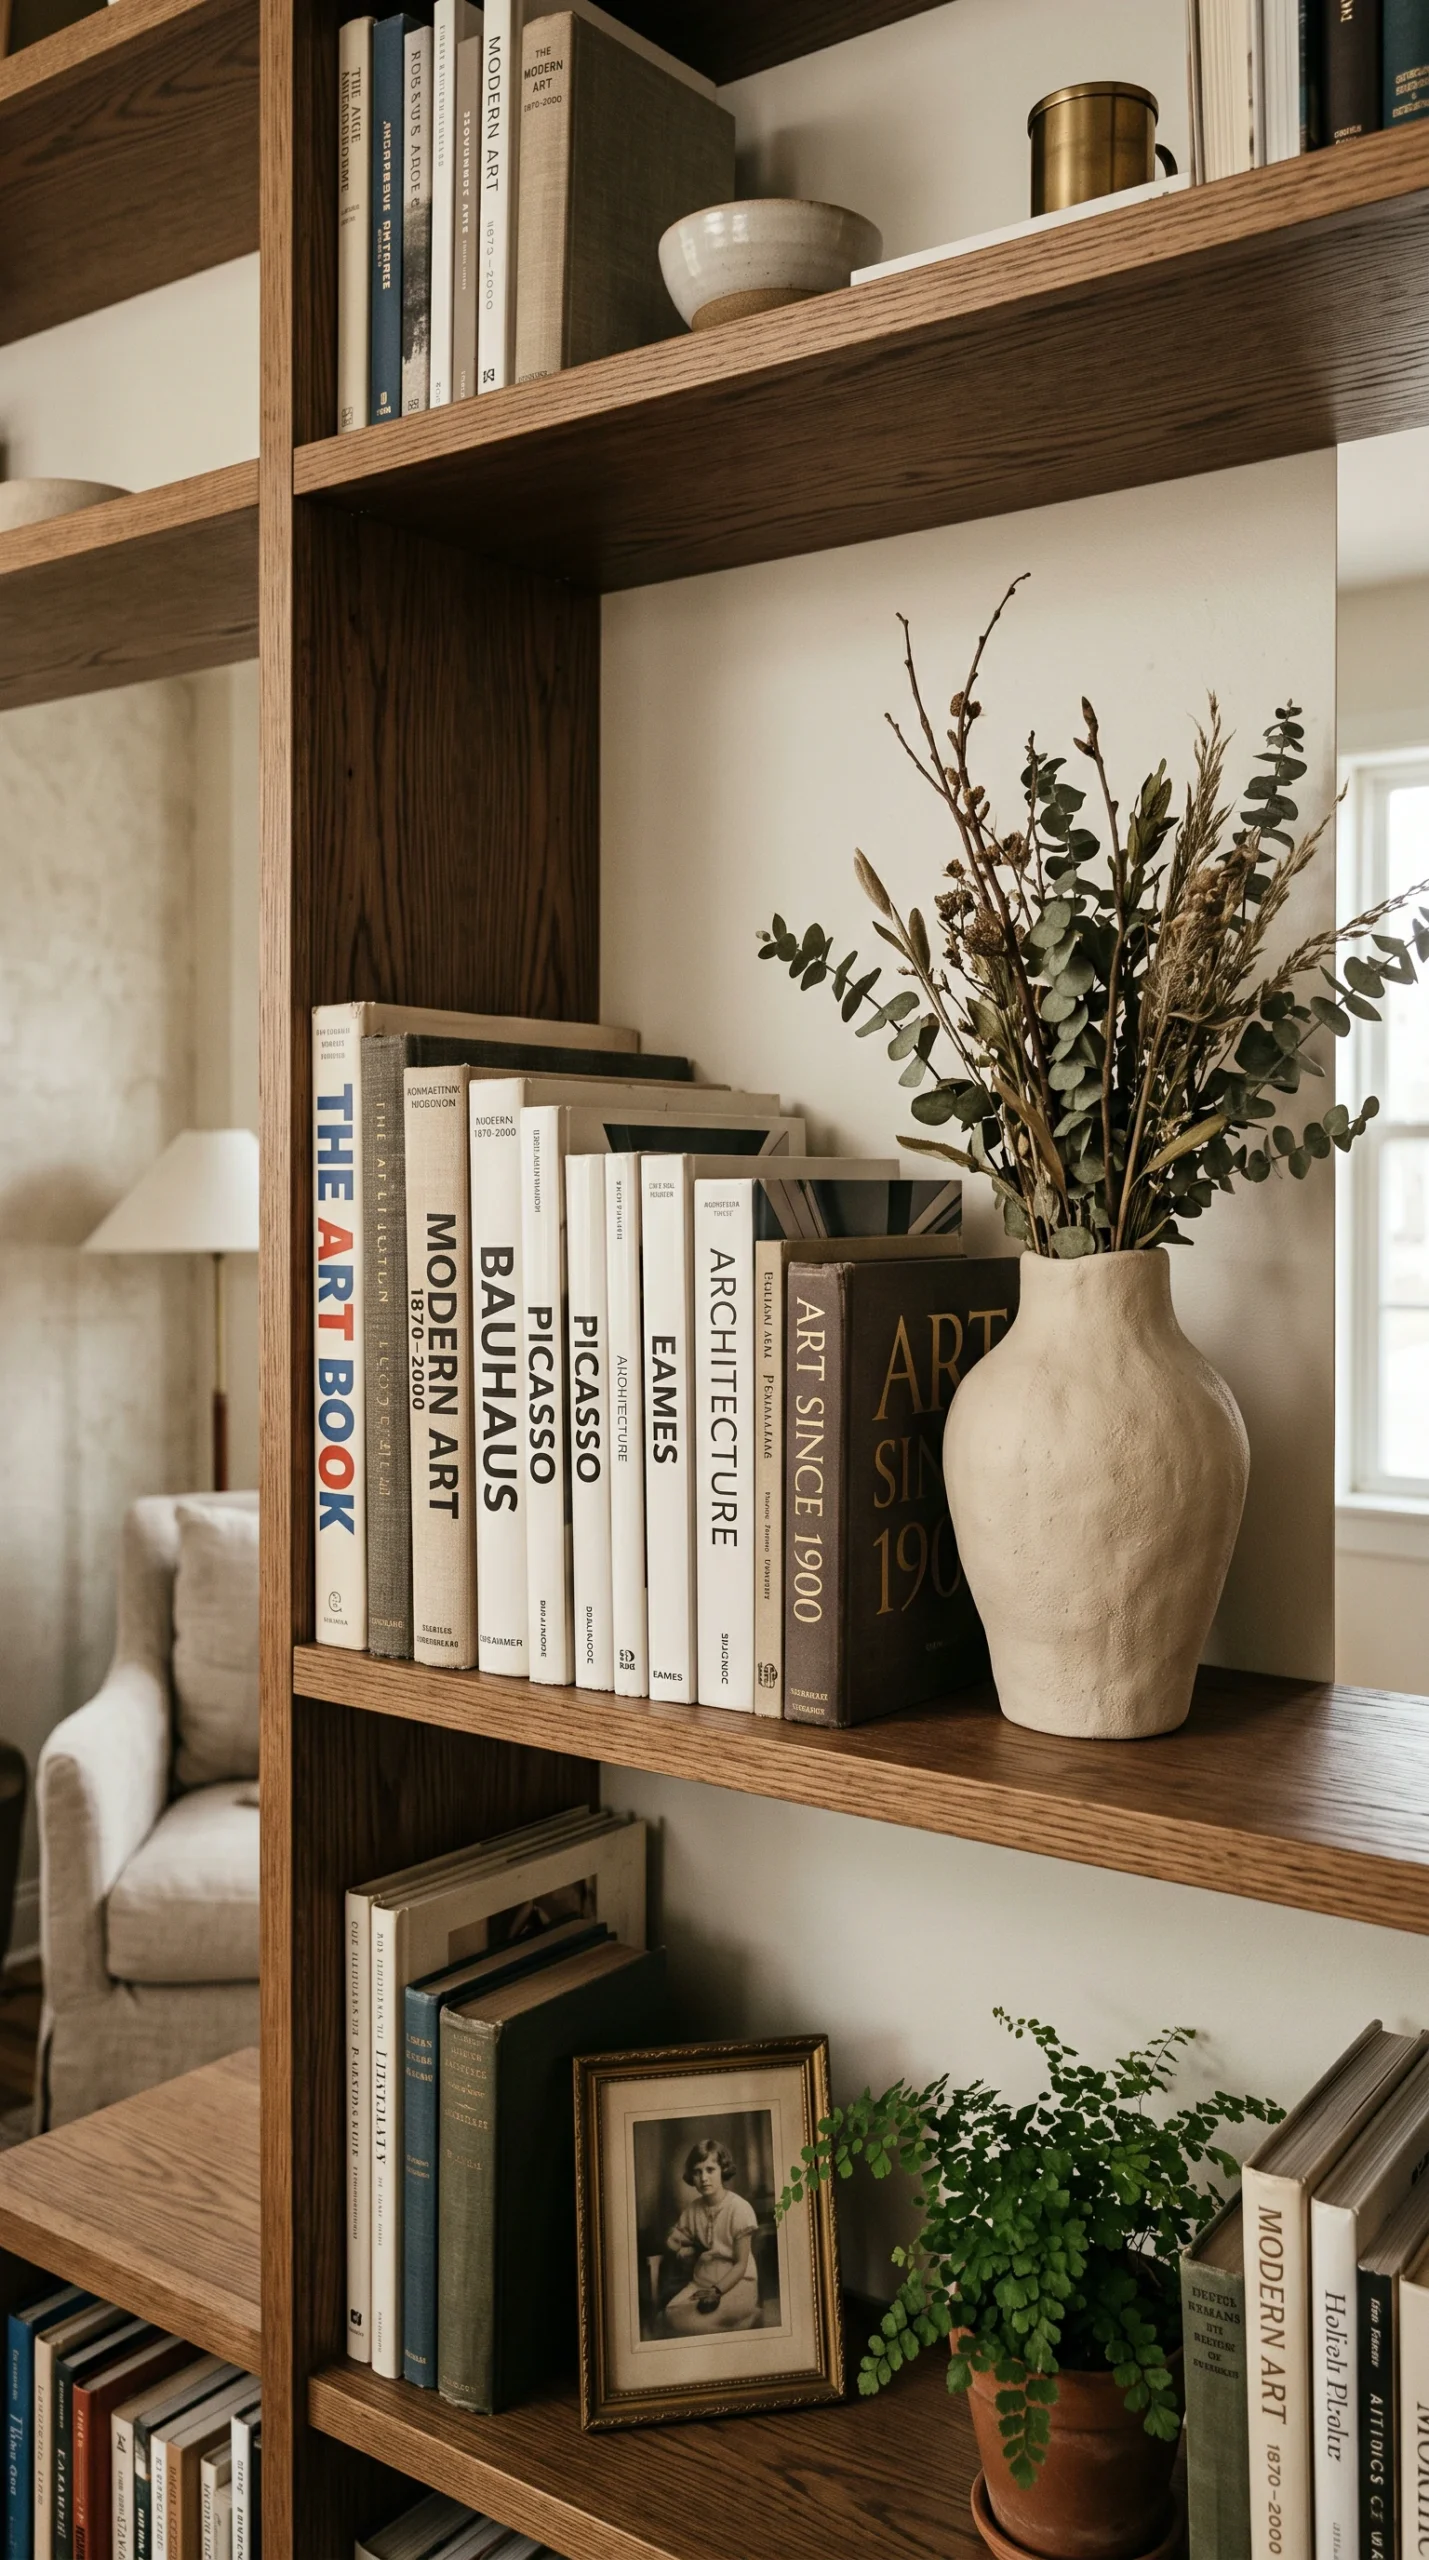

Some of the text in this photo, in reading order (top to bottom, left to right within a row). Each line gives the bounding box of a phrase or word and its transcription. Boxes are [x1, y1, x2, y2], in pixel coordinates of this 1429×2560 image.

[486, 35, 501, 139] MODERN
[525, 60, 563, 80] MODERN
[532, 76, 552, 92] ART
[536, 47, 551, 57] THE
[486, 149, 500, 192] ART
[317, 1083, 355, 1201] THE
[474, 1127, 517, 1138] 1870-2000
[317, 1217, 355, 1342] ART
[427, 1214, 459, 1519] MODERN ART
[481, 1247, 518, 1512] BAUHAUS
[528, 1306, 556, 1485] PICASSO
[574, 1315, 602, 1484] PICASSO
[652, 1336, 677, 1463] EAMES
[711, 1248, 737, 1546] ARCHITECTURE
[872, 1308, 1008, 1421] ART
[317, 1358, 356, 1536] BOOK
[794, 1297, 825, 1622] ART SINCE 1900
[654, 1671, 682, 1681] EAMES
[1259, 2206, 1286, 2554] MODERN ART 1870-2000
